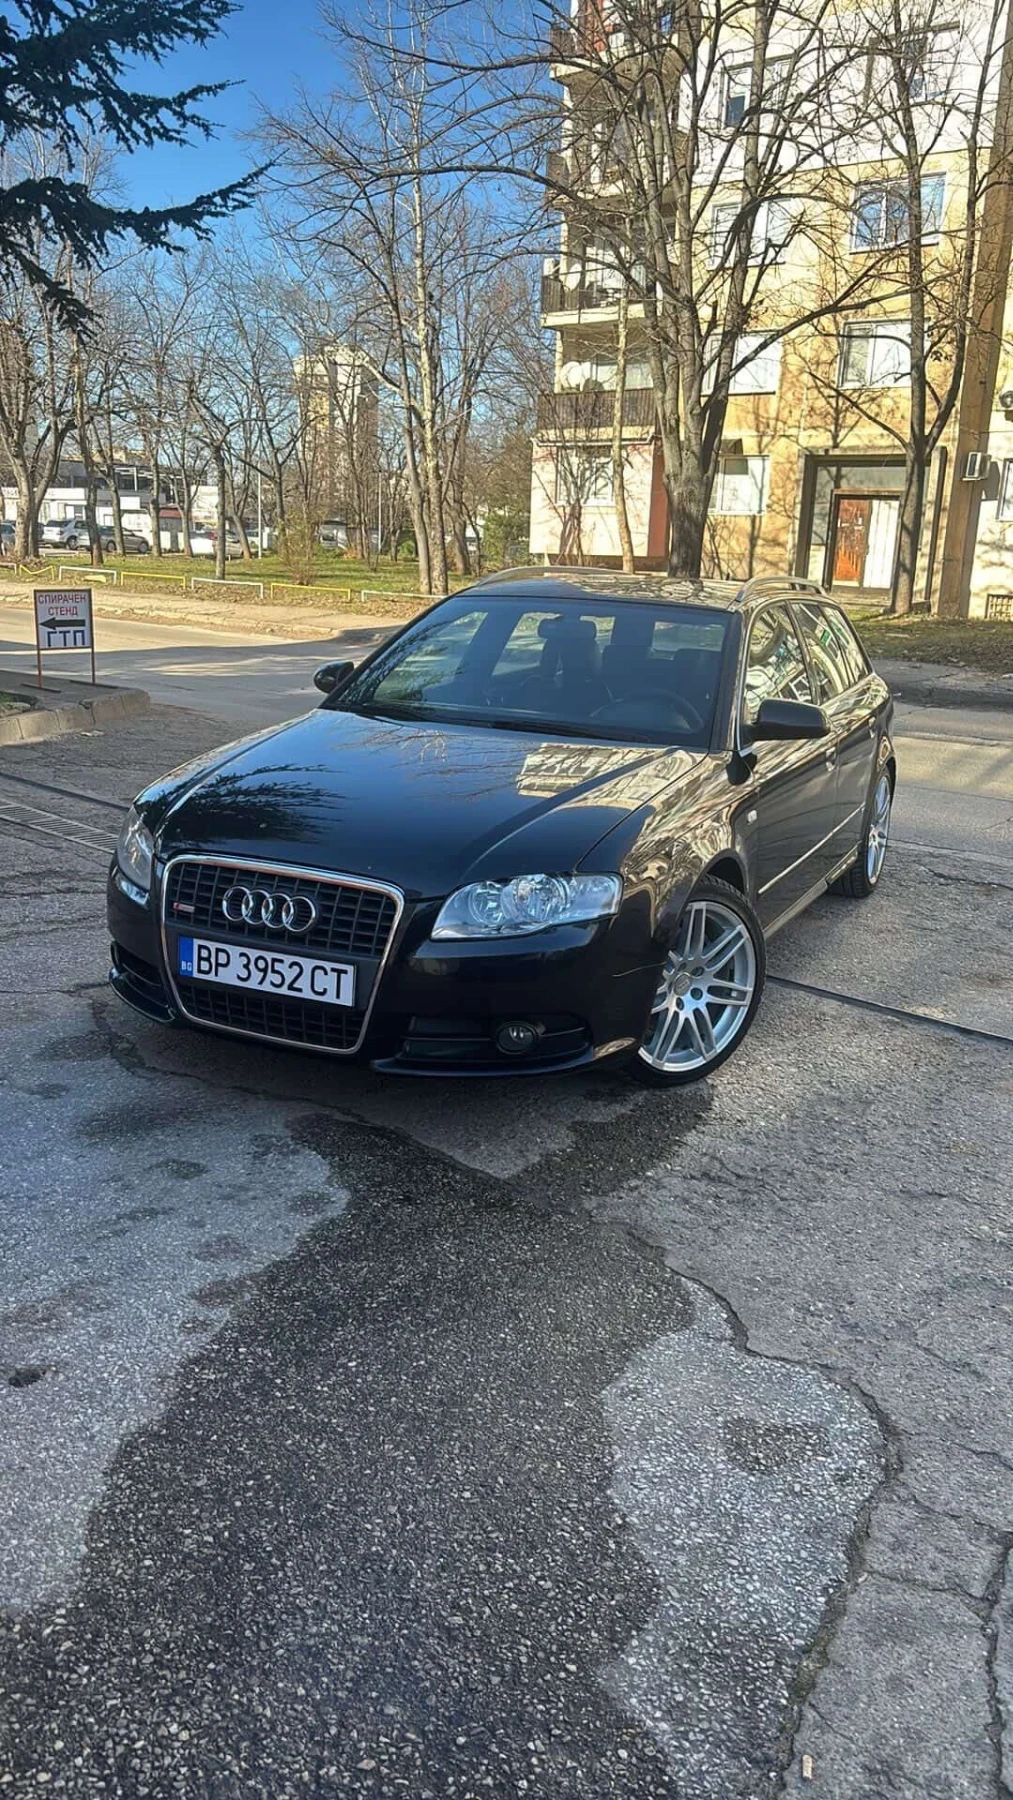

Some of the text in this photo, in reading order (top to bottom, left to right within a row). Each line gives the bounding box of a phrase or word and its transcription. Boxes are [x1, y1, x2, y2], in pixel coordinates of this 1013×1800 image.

[38, 594, 86, 604] СПИРАЧЕН
[47, 606, 78, 616] СТЕНД
[47, 630, 84, 647] ГТП
[181, 960, 193, 972] BG
